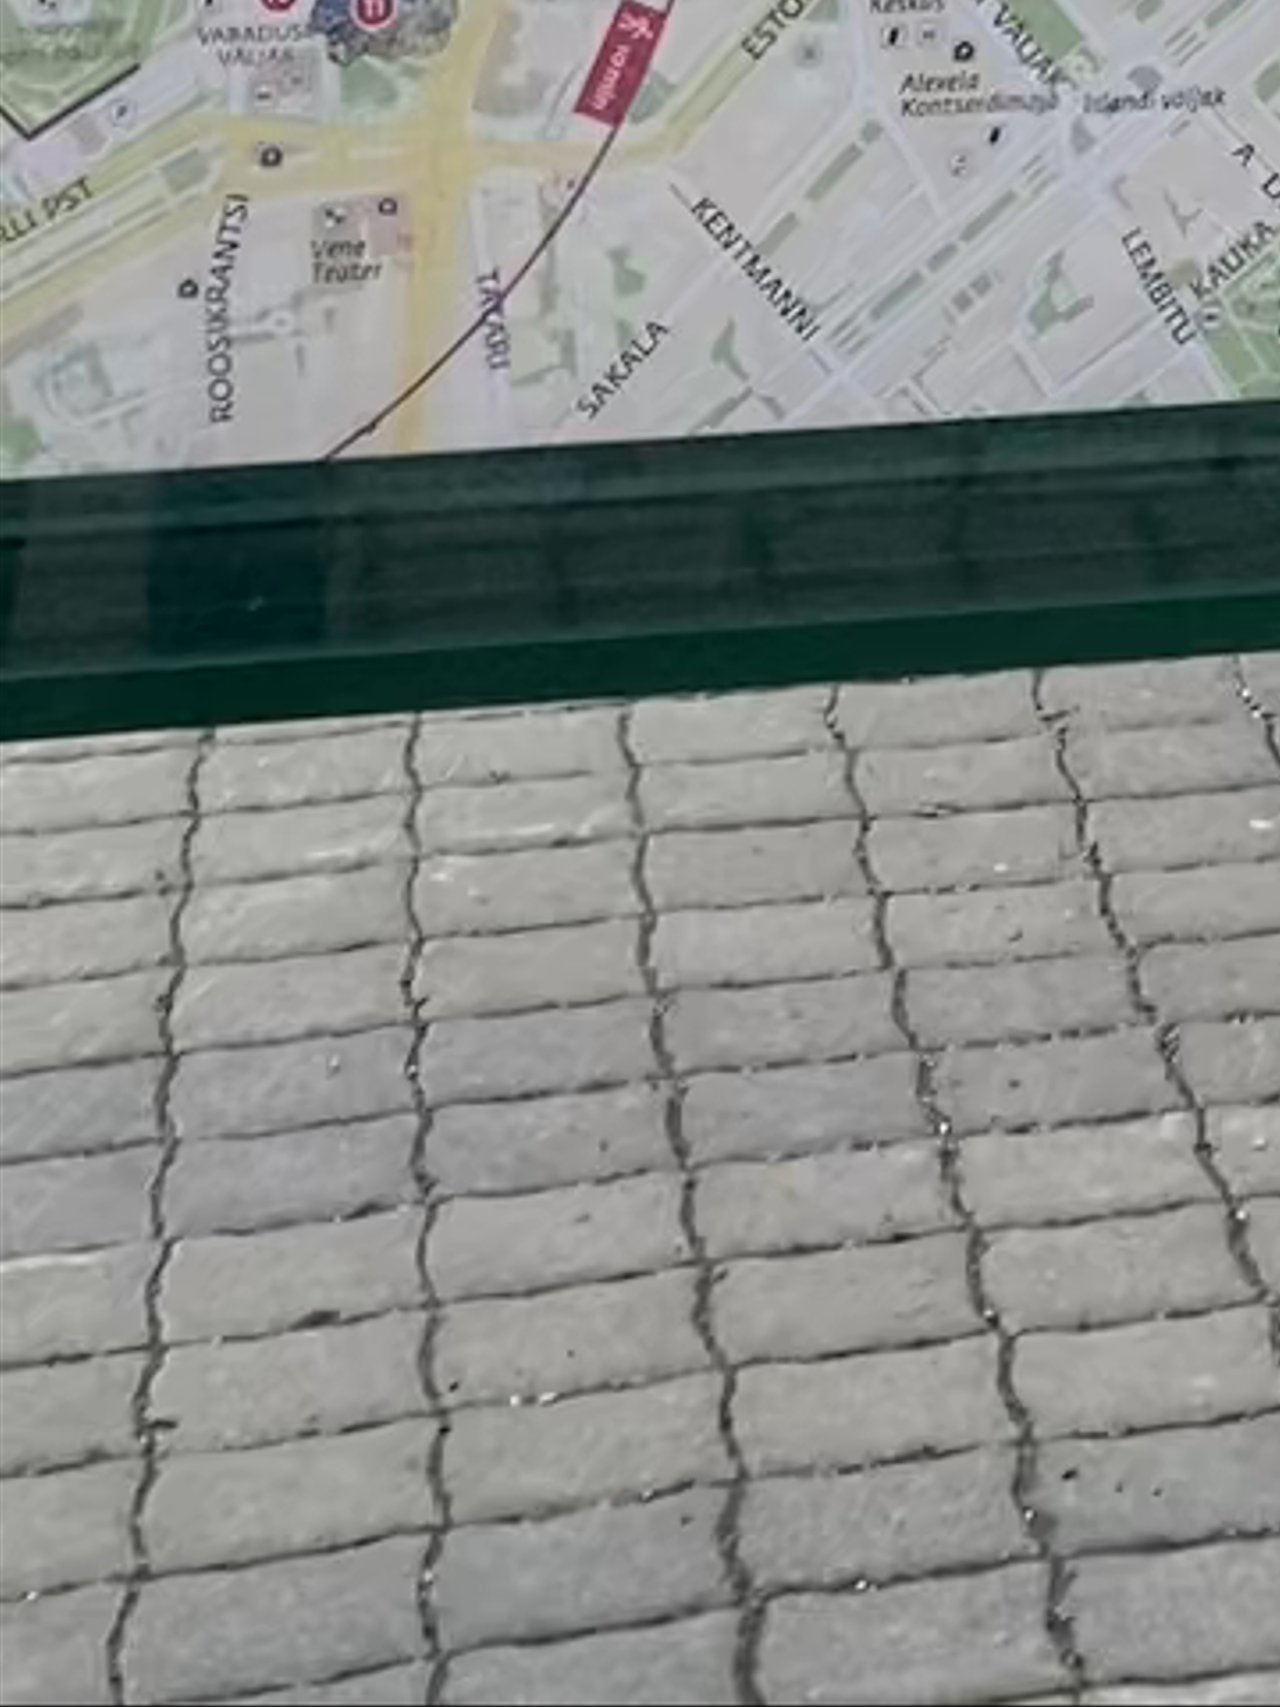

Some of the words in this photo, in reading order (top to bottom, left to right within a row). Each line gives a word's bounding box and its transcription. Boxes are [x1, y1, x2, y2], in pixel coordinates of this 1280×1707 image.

[310, 238, 366, 260] Vene
[312, 260, 384, 283] Teater
[690, 196, 823, 344] KENTMANNI
[1121, 226, 1198, 347] LEMBITU
[199, 193, 250, 425] ROOSIKRANTSI
[574, 319, 671, 421] SAKALA
